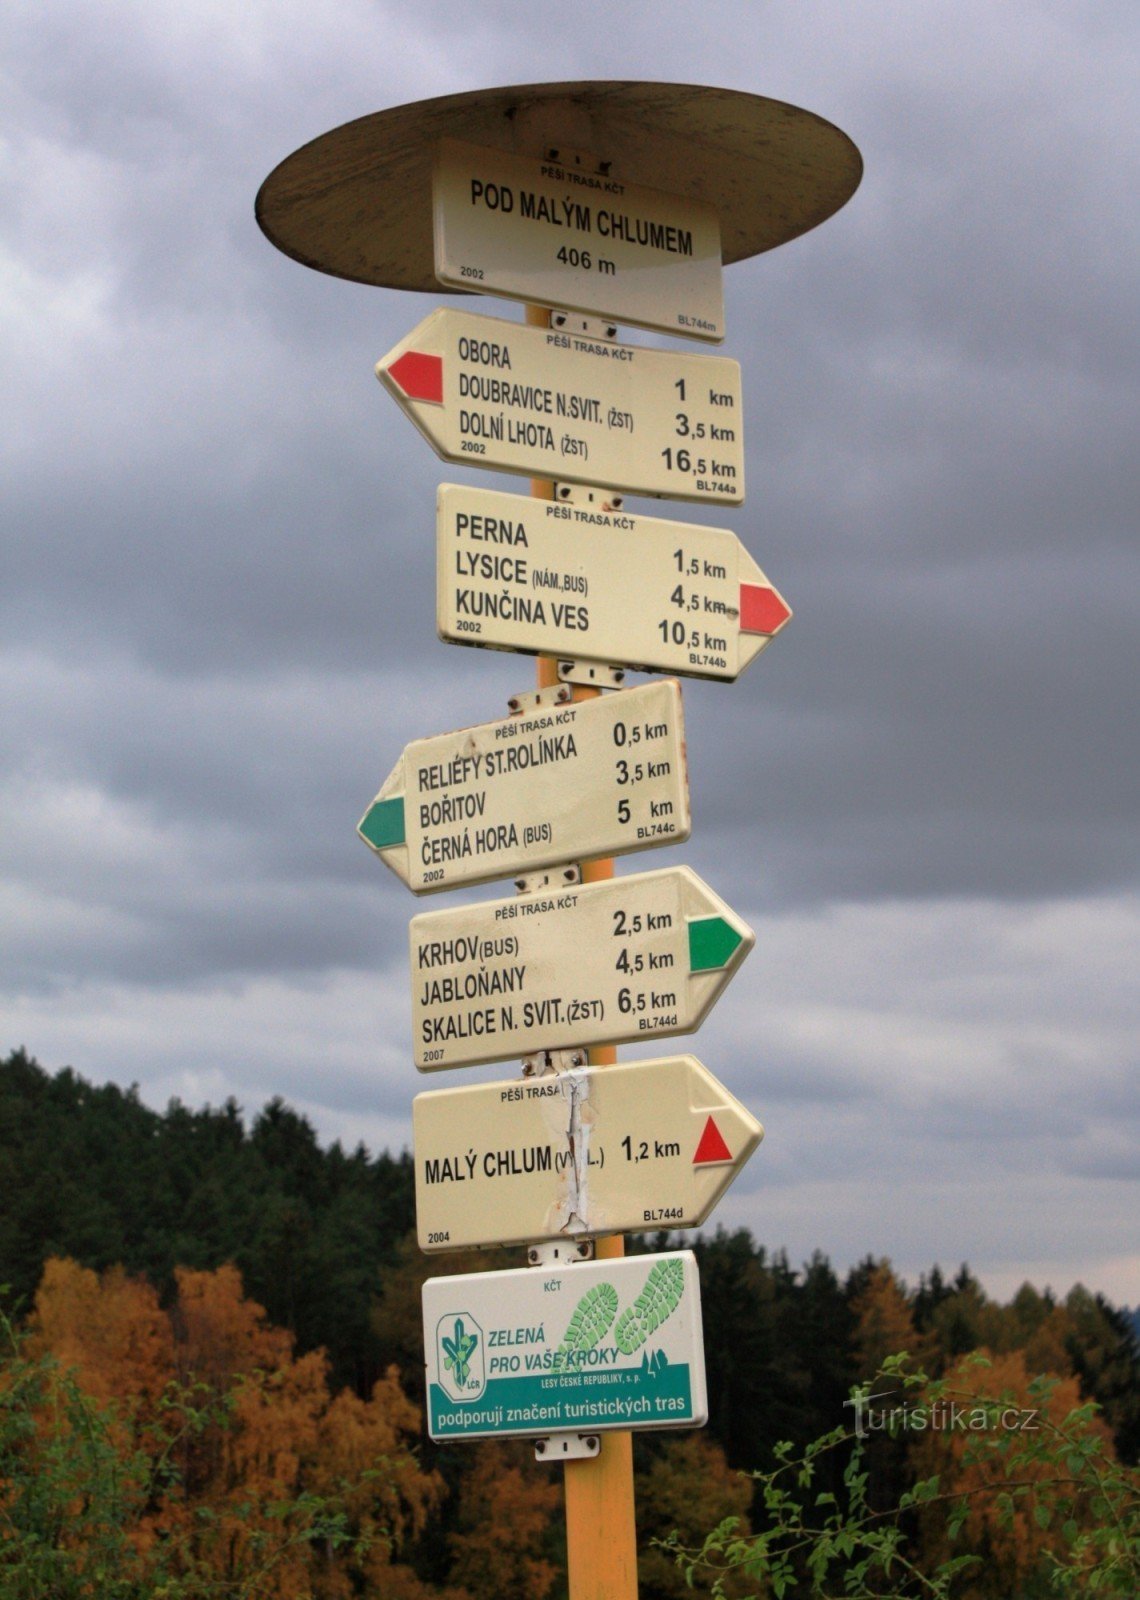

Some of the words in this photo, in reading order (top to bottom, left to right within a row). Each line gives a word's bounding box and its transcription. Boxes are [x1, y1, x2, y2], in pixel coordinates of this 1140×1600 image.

[567, 173, 602, 190] TRASA
[604, 182, 625, 196] KČT
[471, 179, 514, 213] POD
[520, 191, 591, 232] MALÝM
[597, 210, 693, 256] CHLUMEM
[556, 246, 592, 269] 406
[598, 258, 616, 276] m
[460, 266, 484, 280] 2002
[678, 314, 716, 332] BL744m
[573, 340, 610, 356] TRASA
[611, 348, 634, 362] KČT
[458, 336, 512, 370] OBORA
[674, 378, 686, 401] 1
[709, 389, 734, 408] km
[459, 373, 552, 414] DOUBRAVICE
[607, 406, 634, 433] (ŽST)
[676, 413, 706, 440] 3,5
[710, 424, 735, 442] km
[459, 410, 504, 442] DOLNÍ
[508, 420, 554, 450] LHOTA
[560, 434, 588, 460] (ŽST)
[661, 447, 706, 476] 16,5
[712, 459, 736, 478] km
[461, 440, 486, 454] 2002
[696, 480, 736, 494] BL744a
[574, 512, 610, 528] TRASA
[613, 516, 635, 530] KČT
[456, 512, 528, 548] PERNA
[674, 549, 700, 576] 1,5
[704, 562, 726, 579] km
[456, 550, 528, 584] LYSICE
[670, 584, 700, 612] 4,5
[704, 597, 726, 614] km
[456, 588, 546, 626] KUNČINA
[551, 602, 590, 632] VES
[658, 618, 700, 648] 10,5
[704, 633, 727, 652] km
[456, 620, 482, 634] 2002
[689, 653, 727, 668] BL744b
[519, 718, 554, 733] TRASA
[556, 710, 576, 725] KČT
[418, 754, 483, 792] RELIÉFY
[613, 722, 641, 747] 0,5
[645, 723, 668, 740] km
[420, 792, 486, 829] BOŘITOV
[616, 760, 643, 785] 3,5
[647, 761, 671, 778] km
[421, 828, 472, 866] ČERNÁ
[475, 823, 518, 854] HORA
[523, 823, 552, 848] (BUS)
[617, 799, 631, 824] 5
[650, 800, 673, 818] km
[637, 824, 675, 839] BL744c
[423, 869, 445, 883] 2002
[520, 901, 556, 916] TRASA
[557, 896, 579, 909] KČT
[613, 910, 642, 937] 2,5
[647, 913, 672, 930] km
[421, 965, 527, 1006] JABLOŇANY
[615, 949, 644, 975] 4,5
[649, 952, 674, 969] km
[422, 1009, 496, 1044] SKALICE
[617, 988, 646, 1014] 6,5
[651, 991, 676, 1009] km
[639, 1014, 677, 1030] BL744d
[423, 1050, 445, 1062] 2007
[426, 1149, 476, 1184] MALÝ
[483, 1146, 552, 1177] CHLUM
[555, 1147, 604, 1174] (VYL.)
[621, 1136, 649, 1164] 1,2
[654, 1140, 680, 1158] km
[643, 1207, 683, 1222] BL744d
[428, 1232, 450, 1244] 2004
[544, 1281, 562, 1292] KČT
[488, 1323, 545, 1347] ZELENÁ
[489, 1355, 520, 1373] PRO
[524, 1349, 561, 1371] VAŠE
[565, 1347, 620, 1368] KROKY
[541, 1378, 558, 1389] LESY
[559, 1376, 582, 1388] ČESKÉ
[583, 1374, 625, 1386] REPUBLIKY,
[626, 1375, 632, 1383] s.
[634, 1375, 641, 1384] p.
[438, 1406, 503, 1430] podporují
[507, 1403, 561, 1421] značení
[564, 1396, 651, 1421] turistických
[655, 1395, 685, 1412] tras
